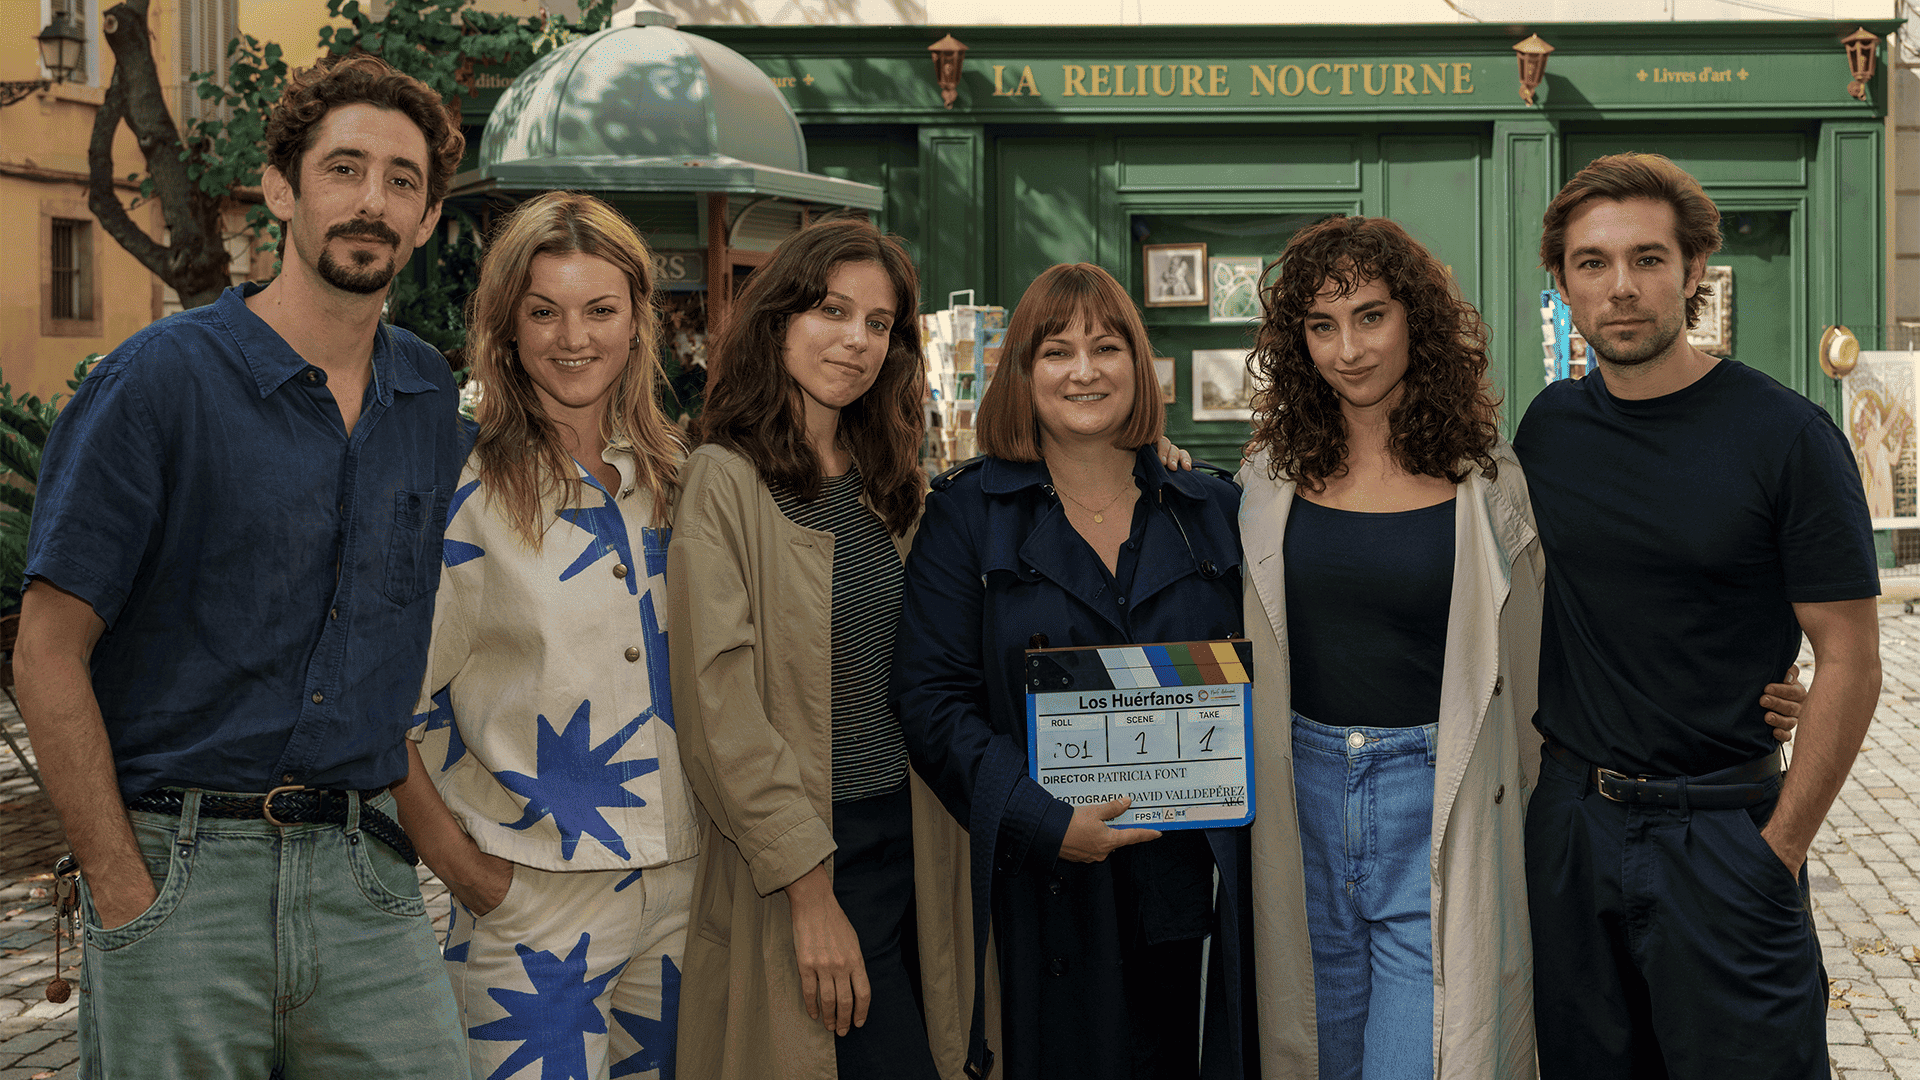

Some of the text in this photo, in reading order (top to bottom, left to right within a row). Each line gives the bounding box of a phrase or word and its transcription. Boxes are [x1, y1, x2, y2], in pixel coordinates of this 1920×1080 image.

[474, 73, 517, 89] ditio
[993, 62, 1475, 97] LA RELIURE NOCTURNE
[1653, 66, 1732, 83] Livres d'art
[1079, 696, 1108, 710] Los
[1112, 691, 1194, 708] Huérfanos
[1051, 719, 1072, 727] ROLL
[1126, 715, 1154, 724] SCENE
[1199, 711, 1220, 719] TAKE
[1134, 731, 1148, 755] 1
[1199, 725, 1216, 752] 1
[1053, 740, 1093, 759] 01
[1042, 767, 1187, 785] DIRECTOR PATRICIA FONT
[1128, 790, 1163, 802] DAVID
[1165, 785, 1245, 800] VALLDEPÉREZ
[1135, 812, 1151, 821] FPS
